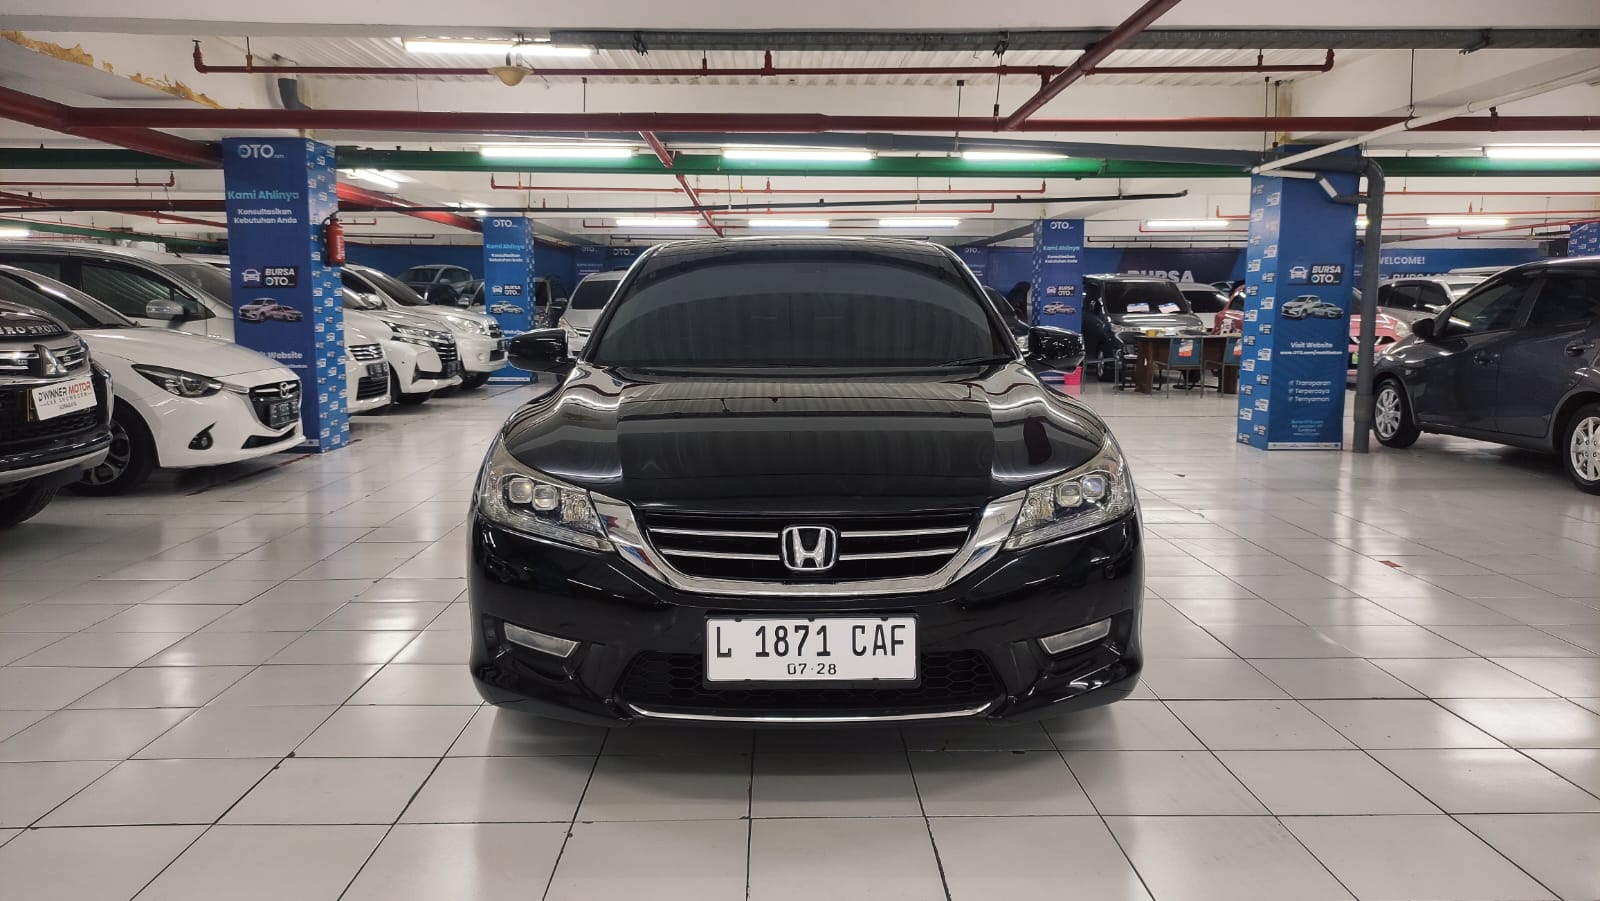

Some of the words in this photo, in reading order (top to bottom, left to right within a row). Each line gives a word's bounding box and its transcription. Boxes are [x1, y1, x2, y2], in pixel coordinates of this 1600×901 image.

[228, 189, 257, 200] Kami
[258, 190, 300, 202] Ahlinya
[265, 268, 295, 276] BURSA
[1311, 265, 1342, 274] BURSA
[68, 381, 91, 394] MOTOR
[716, 626, 732, 658] L
[755, 625, 831, 657] 1871
[852, 624, 906, 656] CAF
